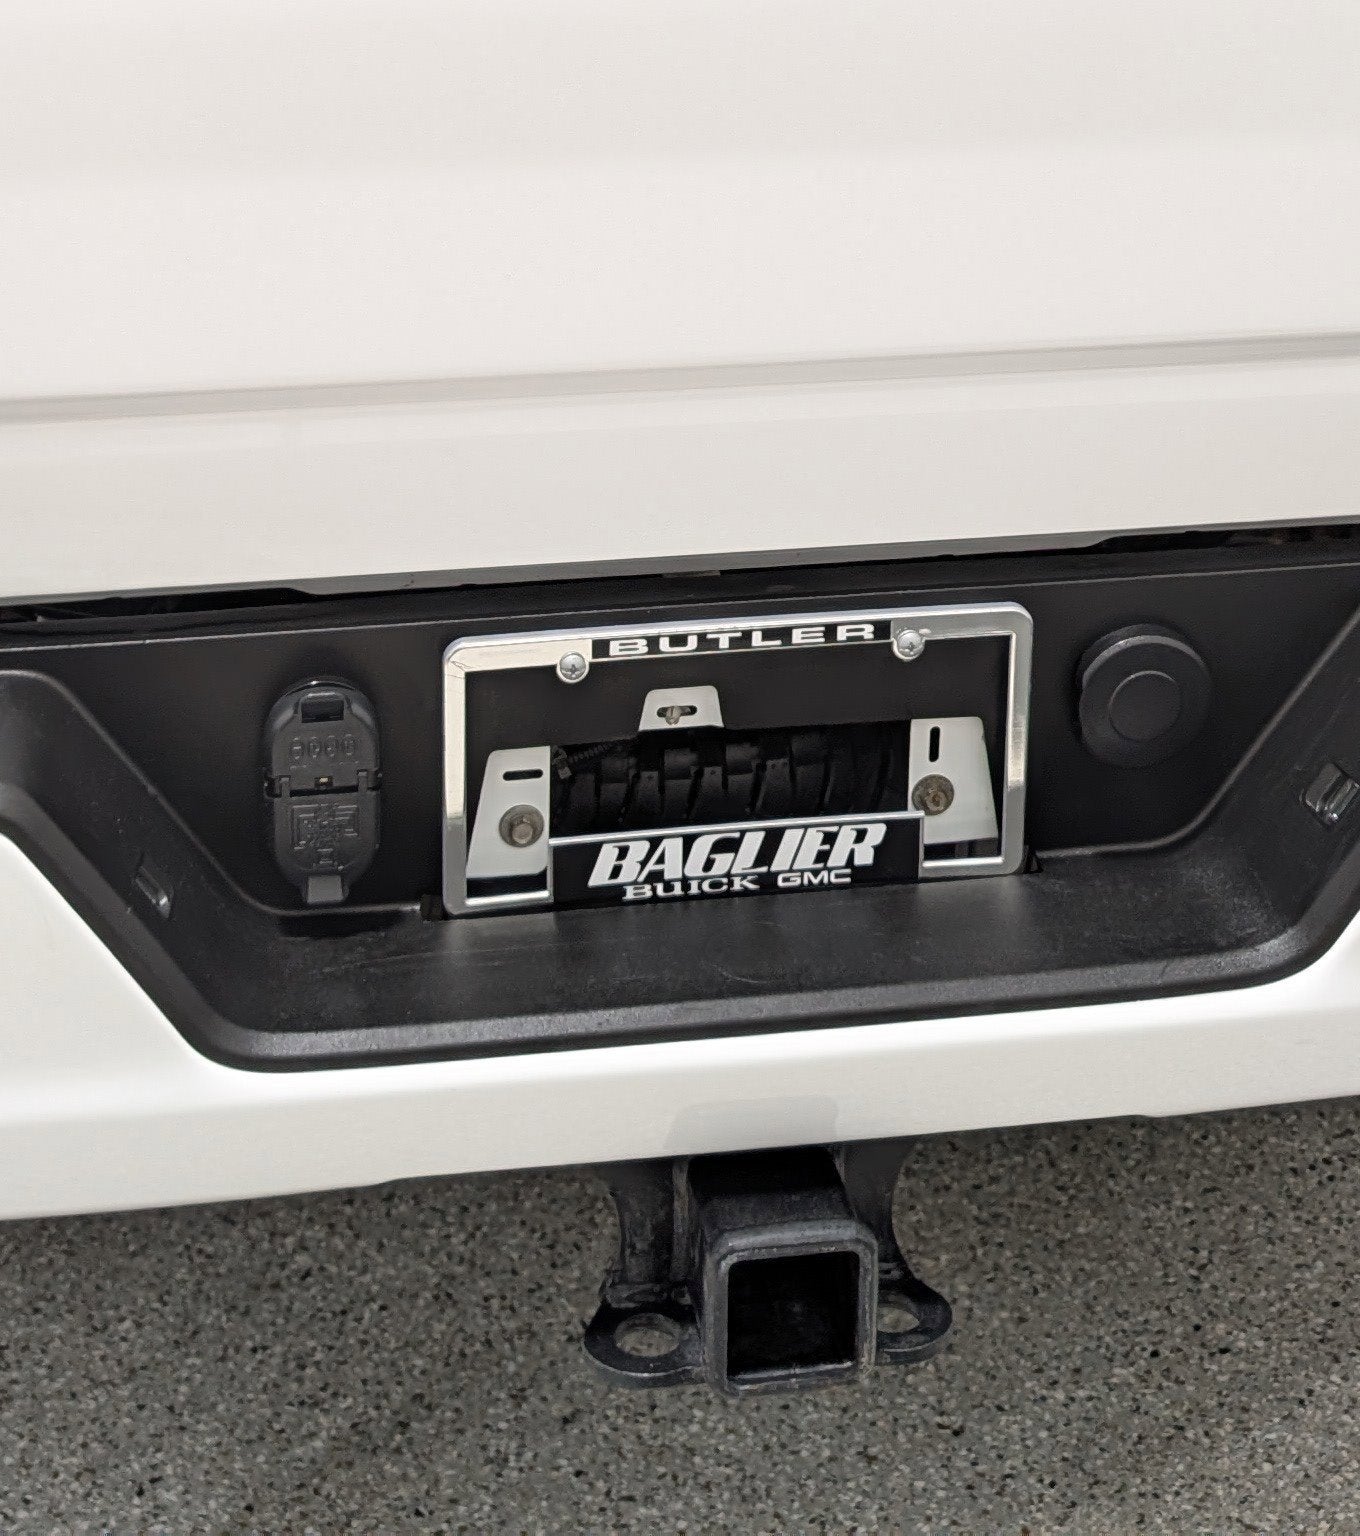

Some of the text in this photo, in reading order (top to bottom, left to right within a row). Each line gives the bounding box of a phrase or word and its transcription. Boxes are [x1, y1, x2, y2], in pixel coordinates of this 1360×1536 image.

[608, 623, 875, 657] BUTLER
[587, 823, 888, 889] BAGLIER
[622, 868, 852, 902] BUICK GMC
